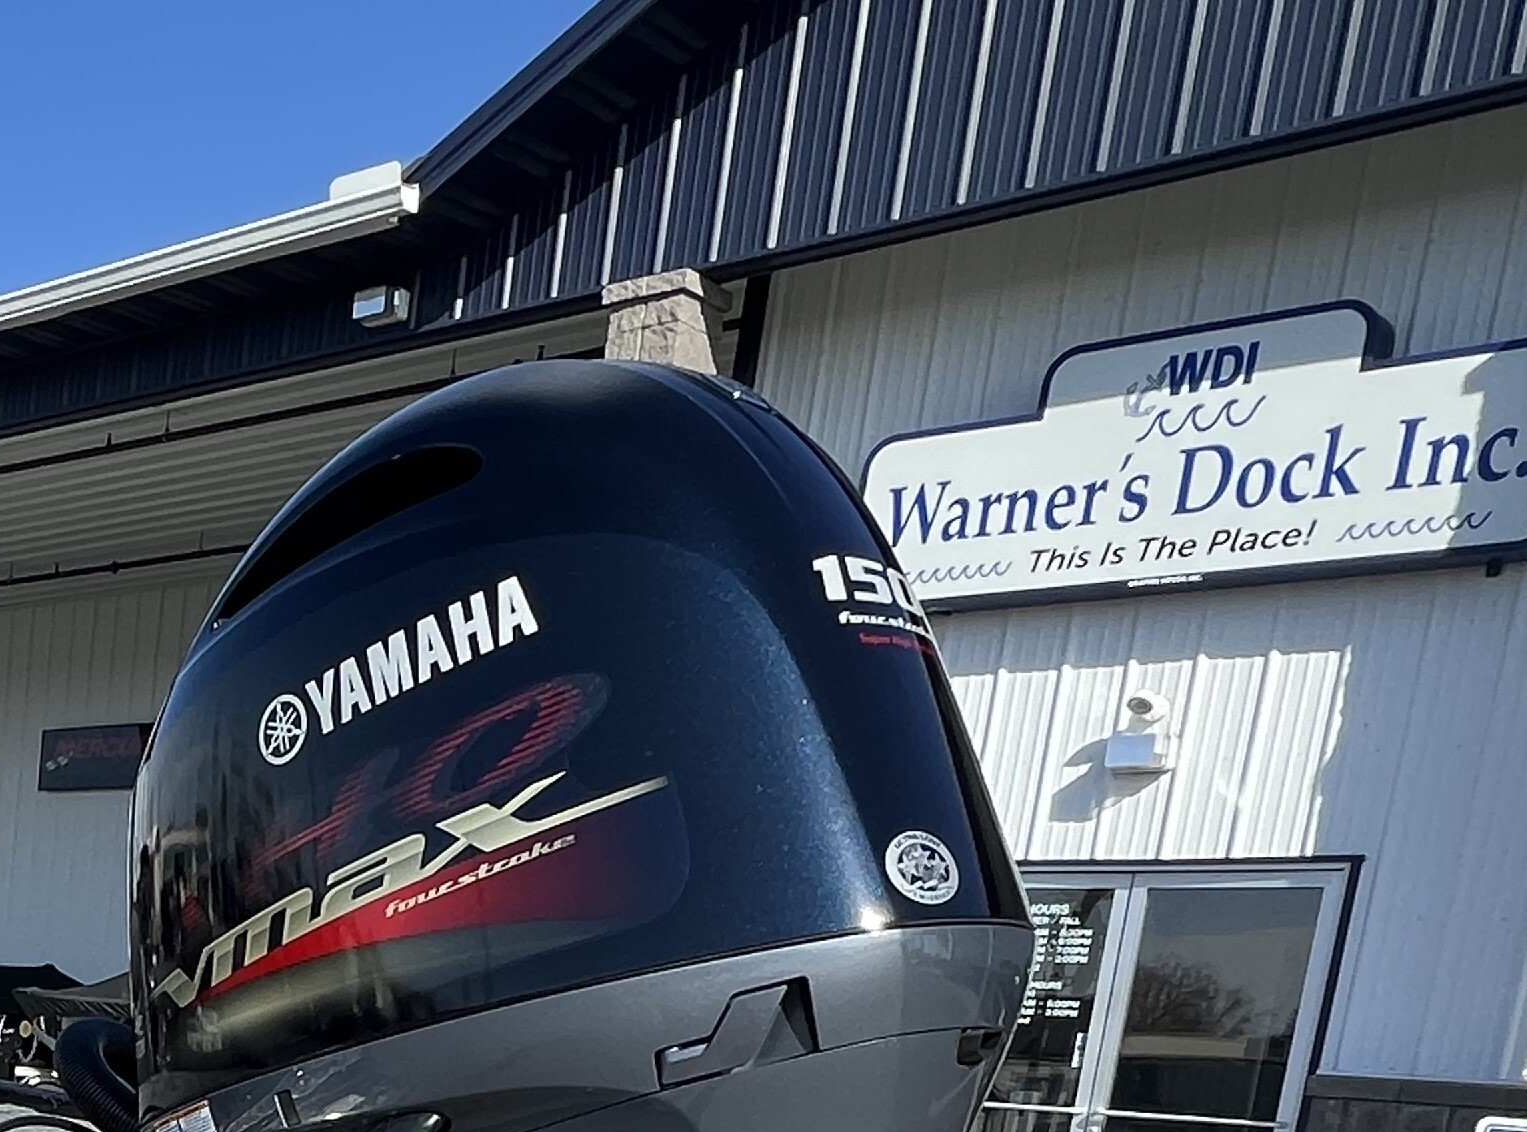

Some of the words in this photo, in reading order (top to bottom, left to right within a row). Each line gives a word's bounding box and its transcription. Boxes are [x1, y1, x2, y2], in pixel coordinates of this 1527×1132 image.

[1168, 340, 1261, 397] WDI
[889, 453, 1151, 548] Warner's
[1171, 423, 1367, 517] Dock
[1385, 416, 1527, 491] Inc.
[1028, 546, 1089, 574] This
[1099, 541, 1127, 567] Is
[1138, 535, 1198, 562] The
[1206, 518, 1318, 556] Place!
[812, 554, 925, 616] 150
[305, 575, 539, 735] YAMAHA
